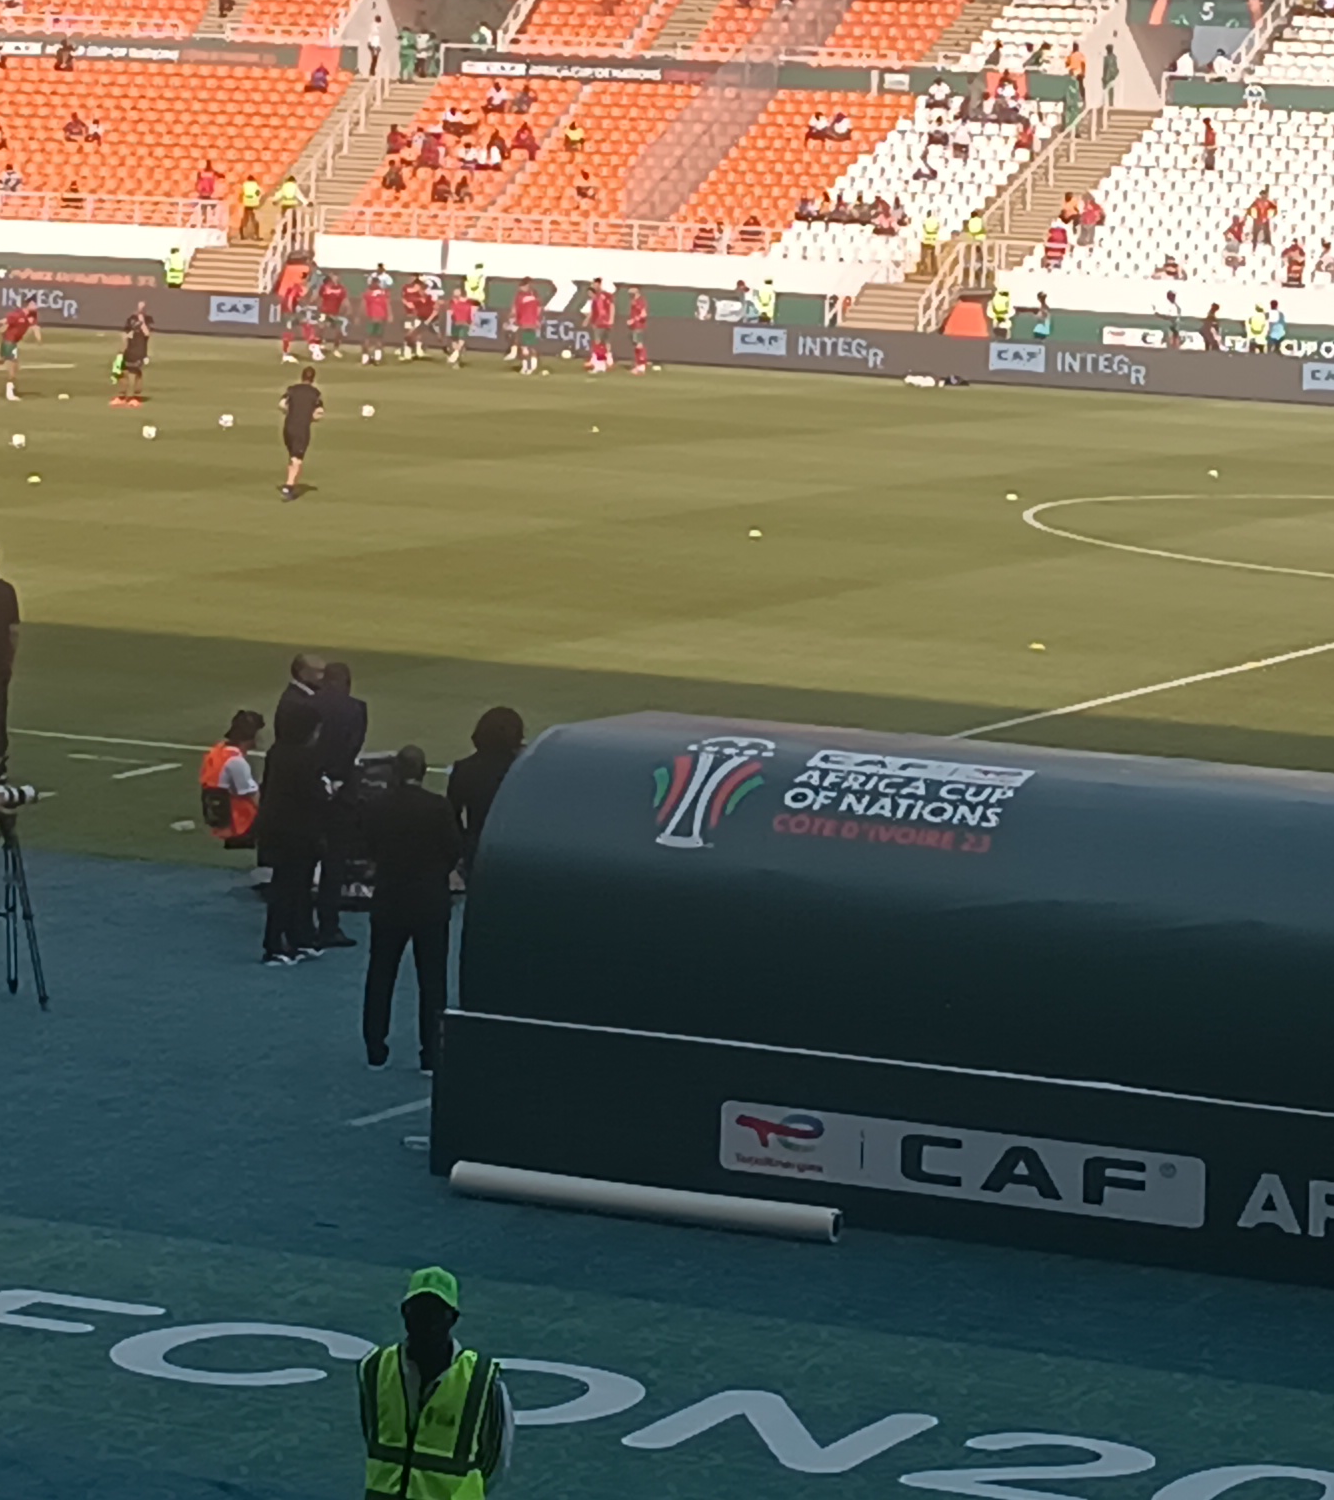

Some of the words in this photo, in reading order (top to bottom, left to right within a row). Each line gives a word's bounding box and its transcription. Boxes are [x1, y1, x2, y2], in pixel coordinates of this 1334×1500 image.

[1199, 1, 1216, 21] 5
[1279, 339, 1318, 359] CUP
[793, 769, 927, 797] AFRICA
[938, 783, 1016, 805] CUP
[783, 786, 839, 811] OF
[837, 793, 1004, 828] NATIONS
[900, 1133, 1147, 1206] CAF
